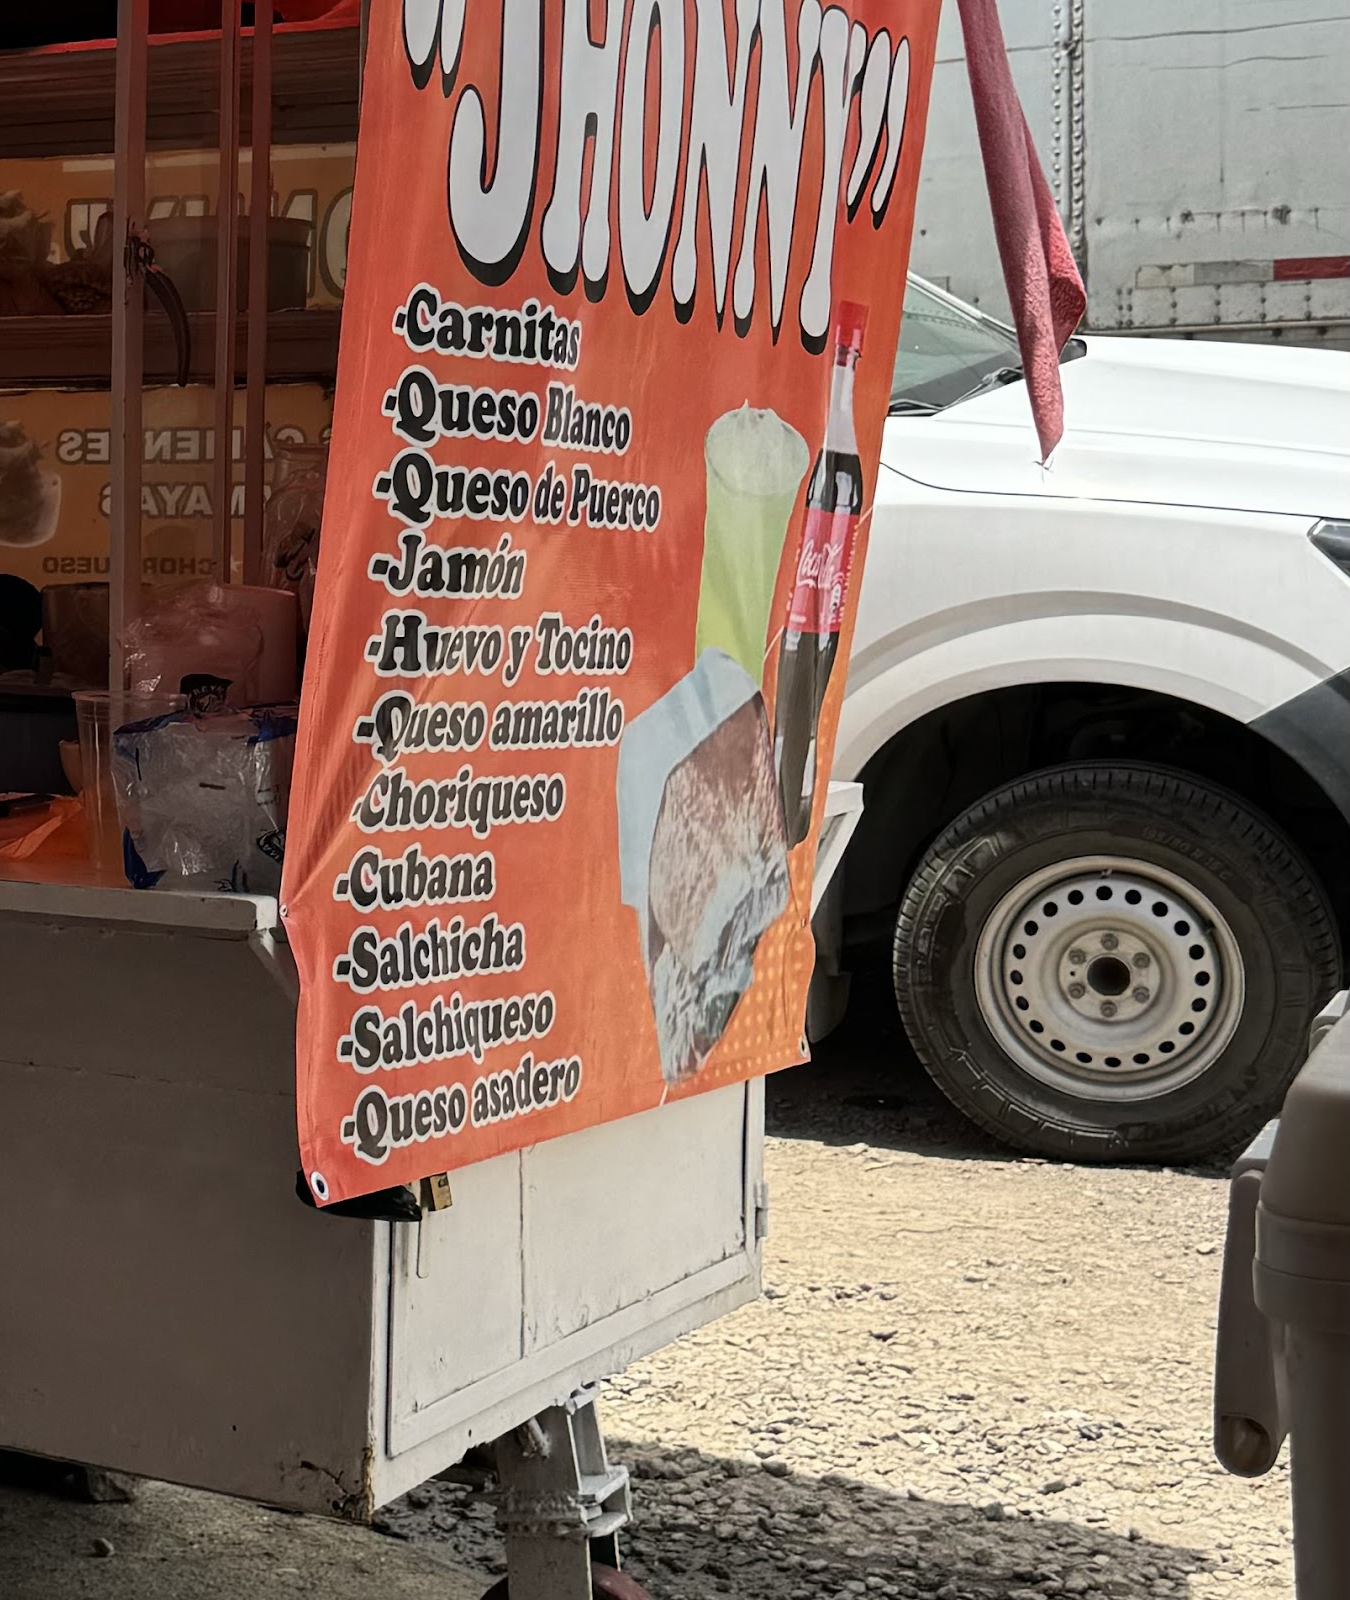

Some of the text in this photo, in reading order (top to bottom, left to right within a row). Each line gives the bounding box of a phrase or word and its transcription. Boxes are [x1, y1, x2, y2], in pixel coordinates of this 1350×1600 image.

[543, 384, 631, 452] Blanco
[533, 465, 565, 523] de
[569, 468, 661, 529] Puerco
[504, 630, 531, 682] y
[536, 617, 632, 670] Tocino
[491, 689, 623, 746] amarillo
[472, 1055, 581, 1125] asadero
